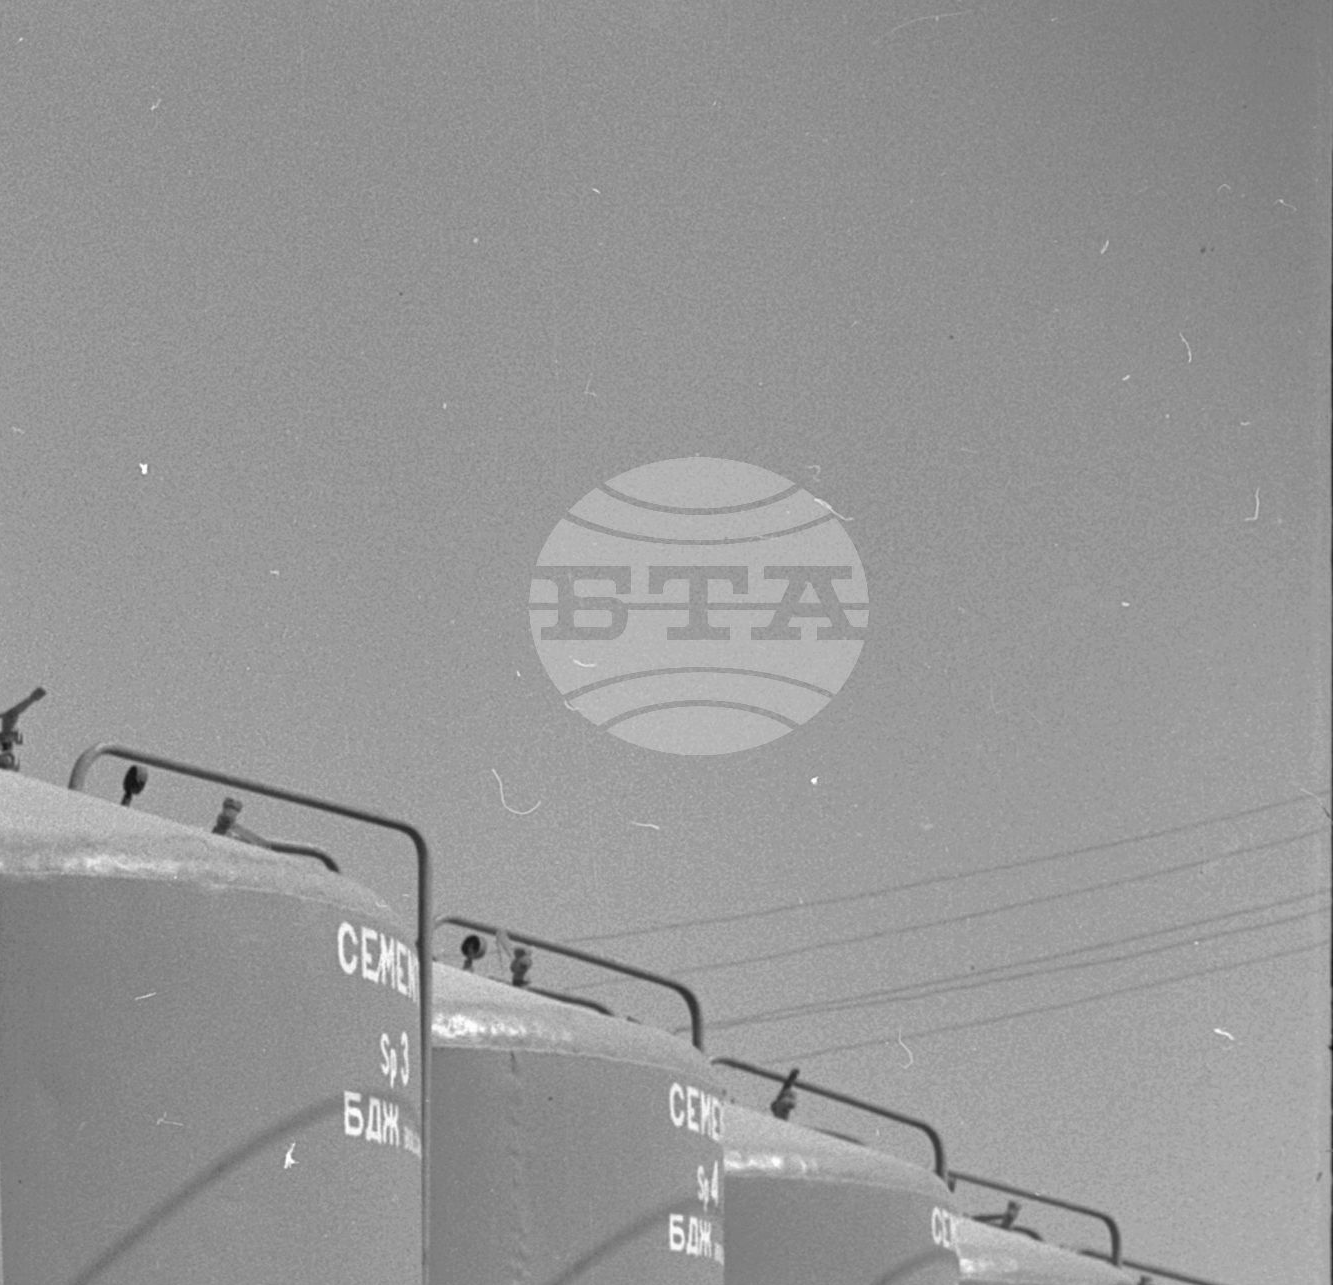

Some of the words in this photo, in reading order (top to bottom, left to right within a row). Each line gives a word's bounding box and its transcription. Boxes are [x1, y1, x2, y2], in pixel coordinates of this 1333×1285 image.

[337, 920, 420, 1005] CEMEN
[343, 1090, 400, 1148] БДЖ
[669, 1213, 712, 1258] БДЖ
